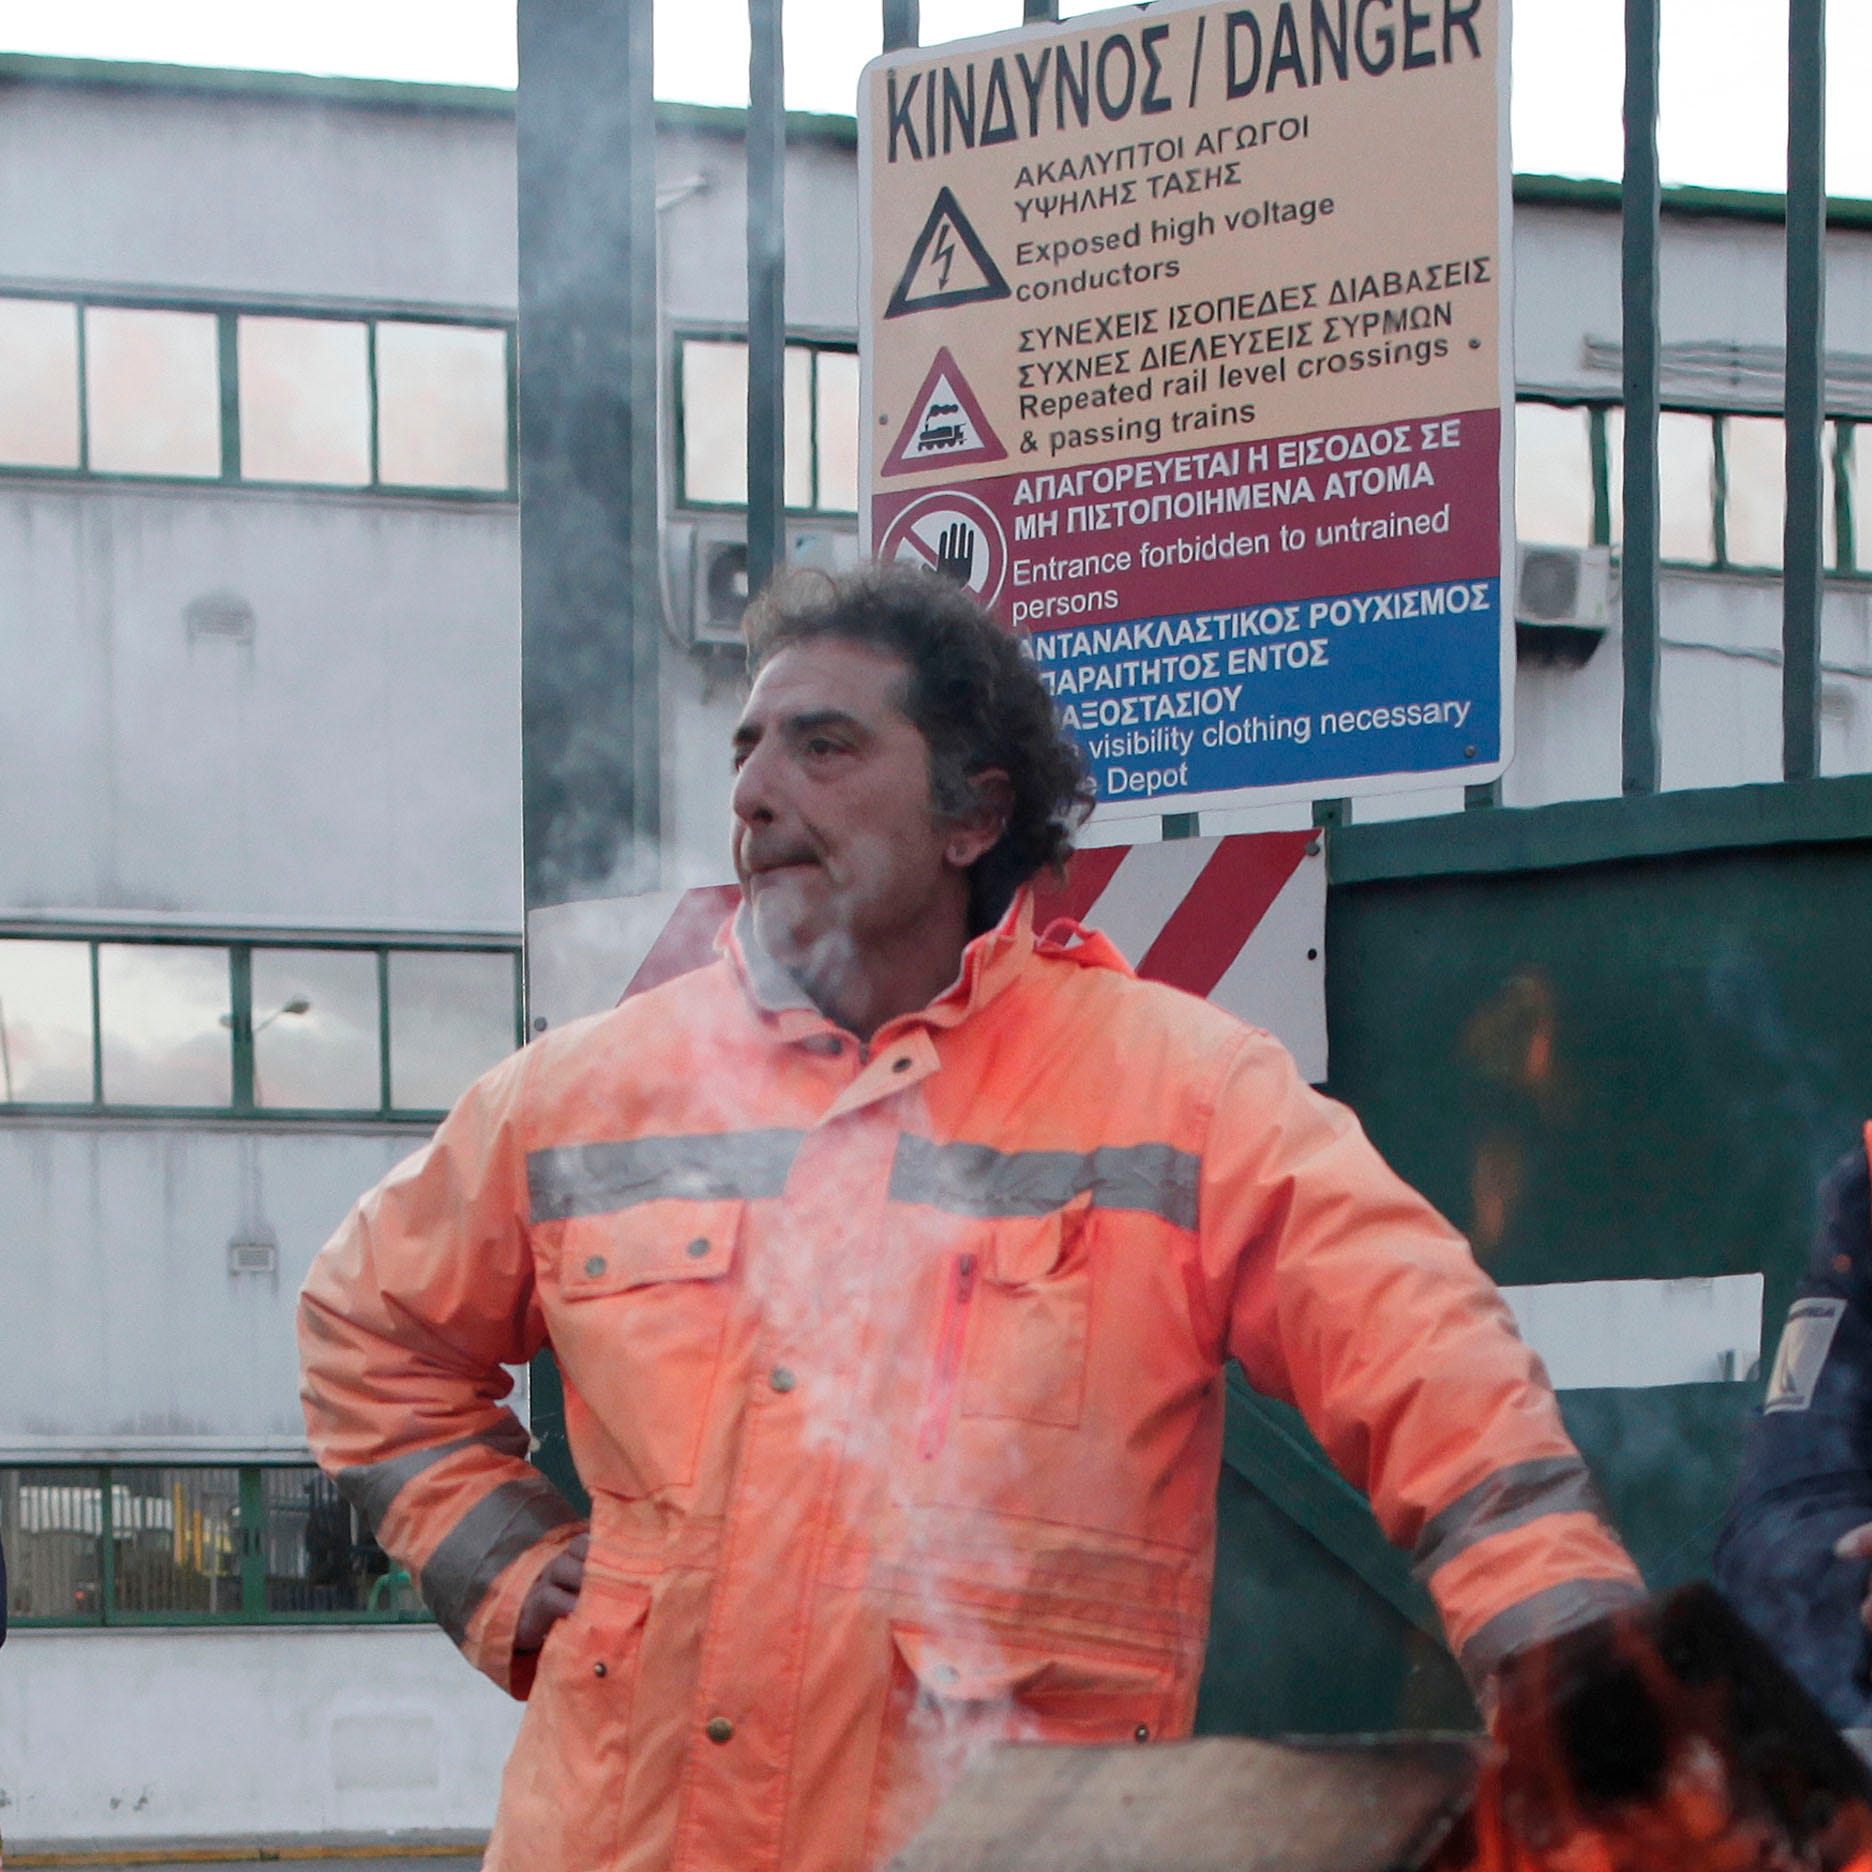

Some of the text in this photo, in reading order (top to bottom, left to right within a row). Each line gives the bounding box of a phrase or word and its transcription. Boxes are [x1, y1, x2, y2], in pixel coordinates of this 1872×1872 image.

[887, 23, 1172, 164] ΚΙΝΔΥΝΟΣ
[1225, 0, 1482, 101] DANGER
[1014, 115, 1309, 189] ΑΚΑΛΥΠΤΟΙ ΑΓΩΓΟΙ
[1015, 161, 1242, 223] ΥΨΗΛΗΣ ΤΑΣΗΣ
[1016, 197, 1335, 267] Exposed high voltage
[1015, 258, 1180, 302] conductors
[1019, 256, 1492, 353] ΣΥΝΕΧΕΙΣ ΙΣΟΠΕΔΕΣ ΔΙΑΒΑΣΕΙΣ
[1019, 301, 1453, 389] ΣΥΧΝΕΣ ΔΙΕΛΕΥΣΕΙΣ ΣΥΡΜΩΝ
[1020, 335, 1448, 421] Repeated rail level crossings
[1013, 418, 1461, 505] ΑΠΑΓΟΡΕΥΕΤΑΙ Η ΕΙΣΟΔΟΣ ΣΕ
[1019, 402, 1256, 457] & passing trains
[1014, 461, 1435, 541] ΜΗ ΠΙΣΤΟΠΟΙΗΜΕΝΑ ΑΤΟΜΑ
[1013, 504, 1451, 586] Entrance forbidden to untrained
[1012, 587, 1119, 626] persons
[1309, 583, 1491, 629] ΡΟΥΧΙΣΜΟΣ
[1228, 638, 1329, 676] ΕΝΤΟΣ
[1088, 726, 1194, 760] visibility
[1203, 710, 1312, 748] clothing
[1320, 700, 1471, 736] necessary
[1107, 762, 1189, 796] Depot
